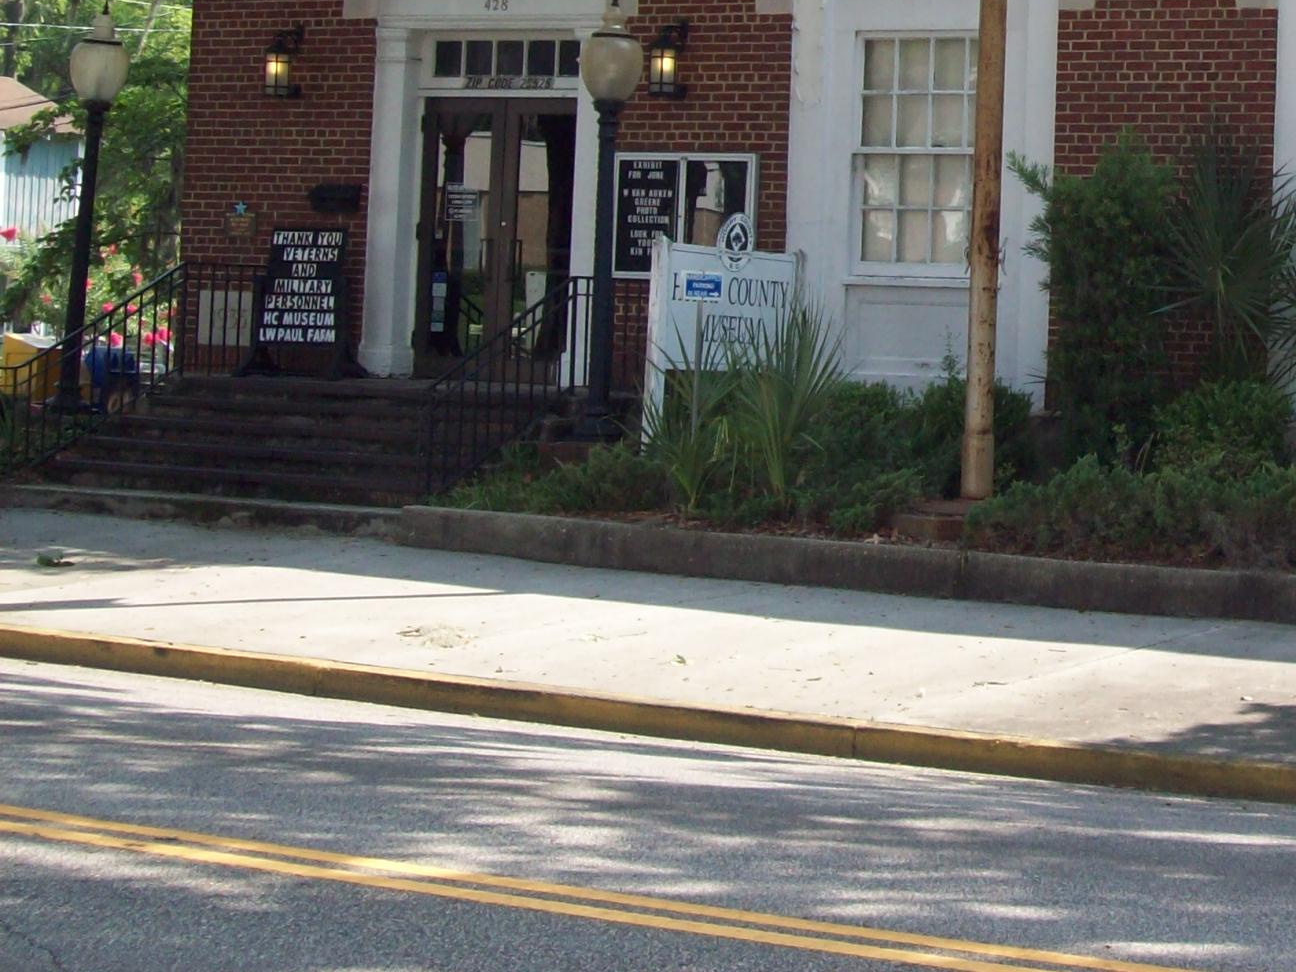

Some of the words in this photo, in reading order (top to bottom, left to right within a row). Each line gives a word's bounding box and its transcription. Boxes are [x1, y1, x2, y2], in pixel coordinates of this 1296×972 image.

[466, 77, 482, 89] ZIP
[488, 77, 513, 89] CODE
[633, 161, 663, 170] EXHIBIT
[628, 171, 642, 180] FOR
[647, 171, 664, 181] JUNE
[636, 207, 658, 215] PHOTO
[627, 215, 670, 225] COLLECTION
[273, 231, 314, 245] THANK
[318, 232, 343, 246] YOU
[630, 230, 648, 239] LOOK
[283, 247, 338, 261] VETERNS
[292, 263, 317, 277] AND
[274, 279, 332, 293] MILITARY
[728, 277, 789, 308] COUNTY
[265, 295, 335, 309] PERSONNEL
[263, 312, 279, 325] HC
[282, 312, 335, 326] MUSEUM
[259, 328, 276, 341] LW
[277, 329, 304, 342] PAUL
